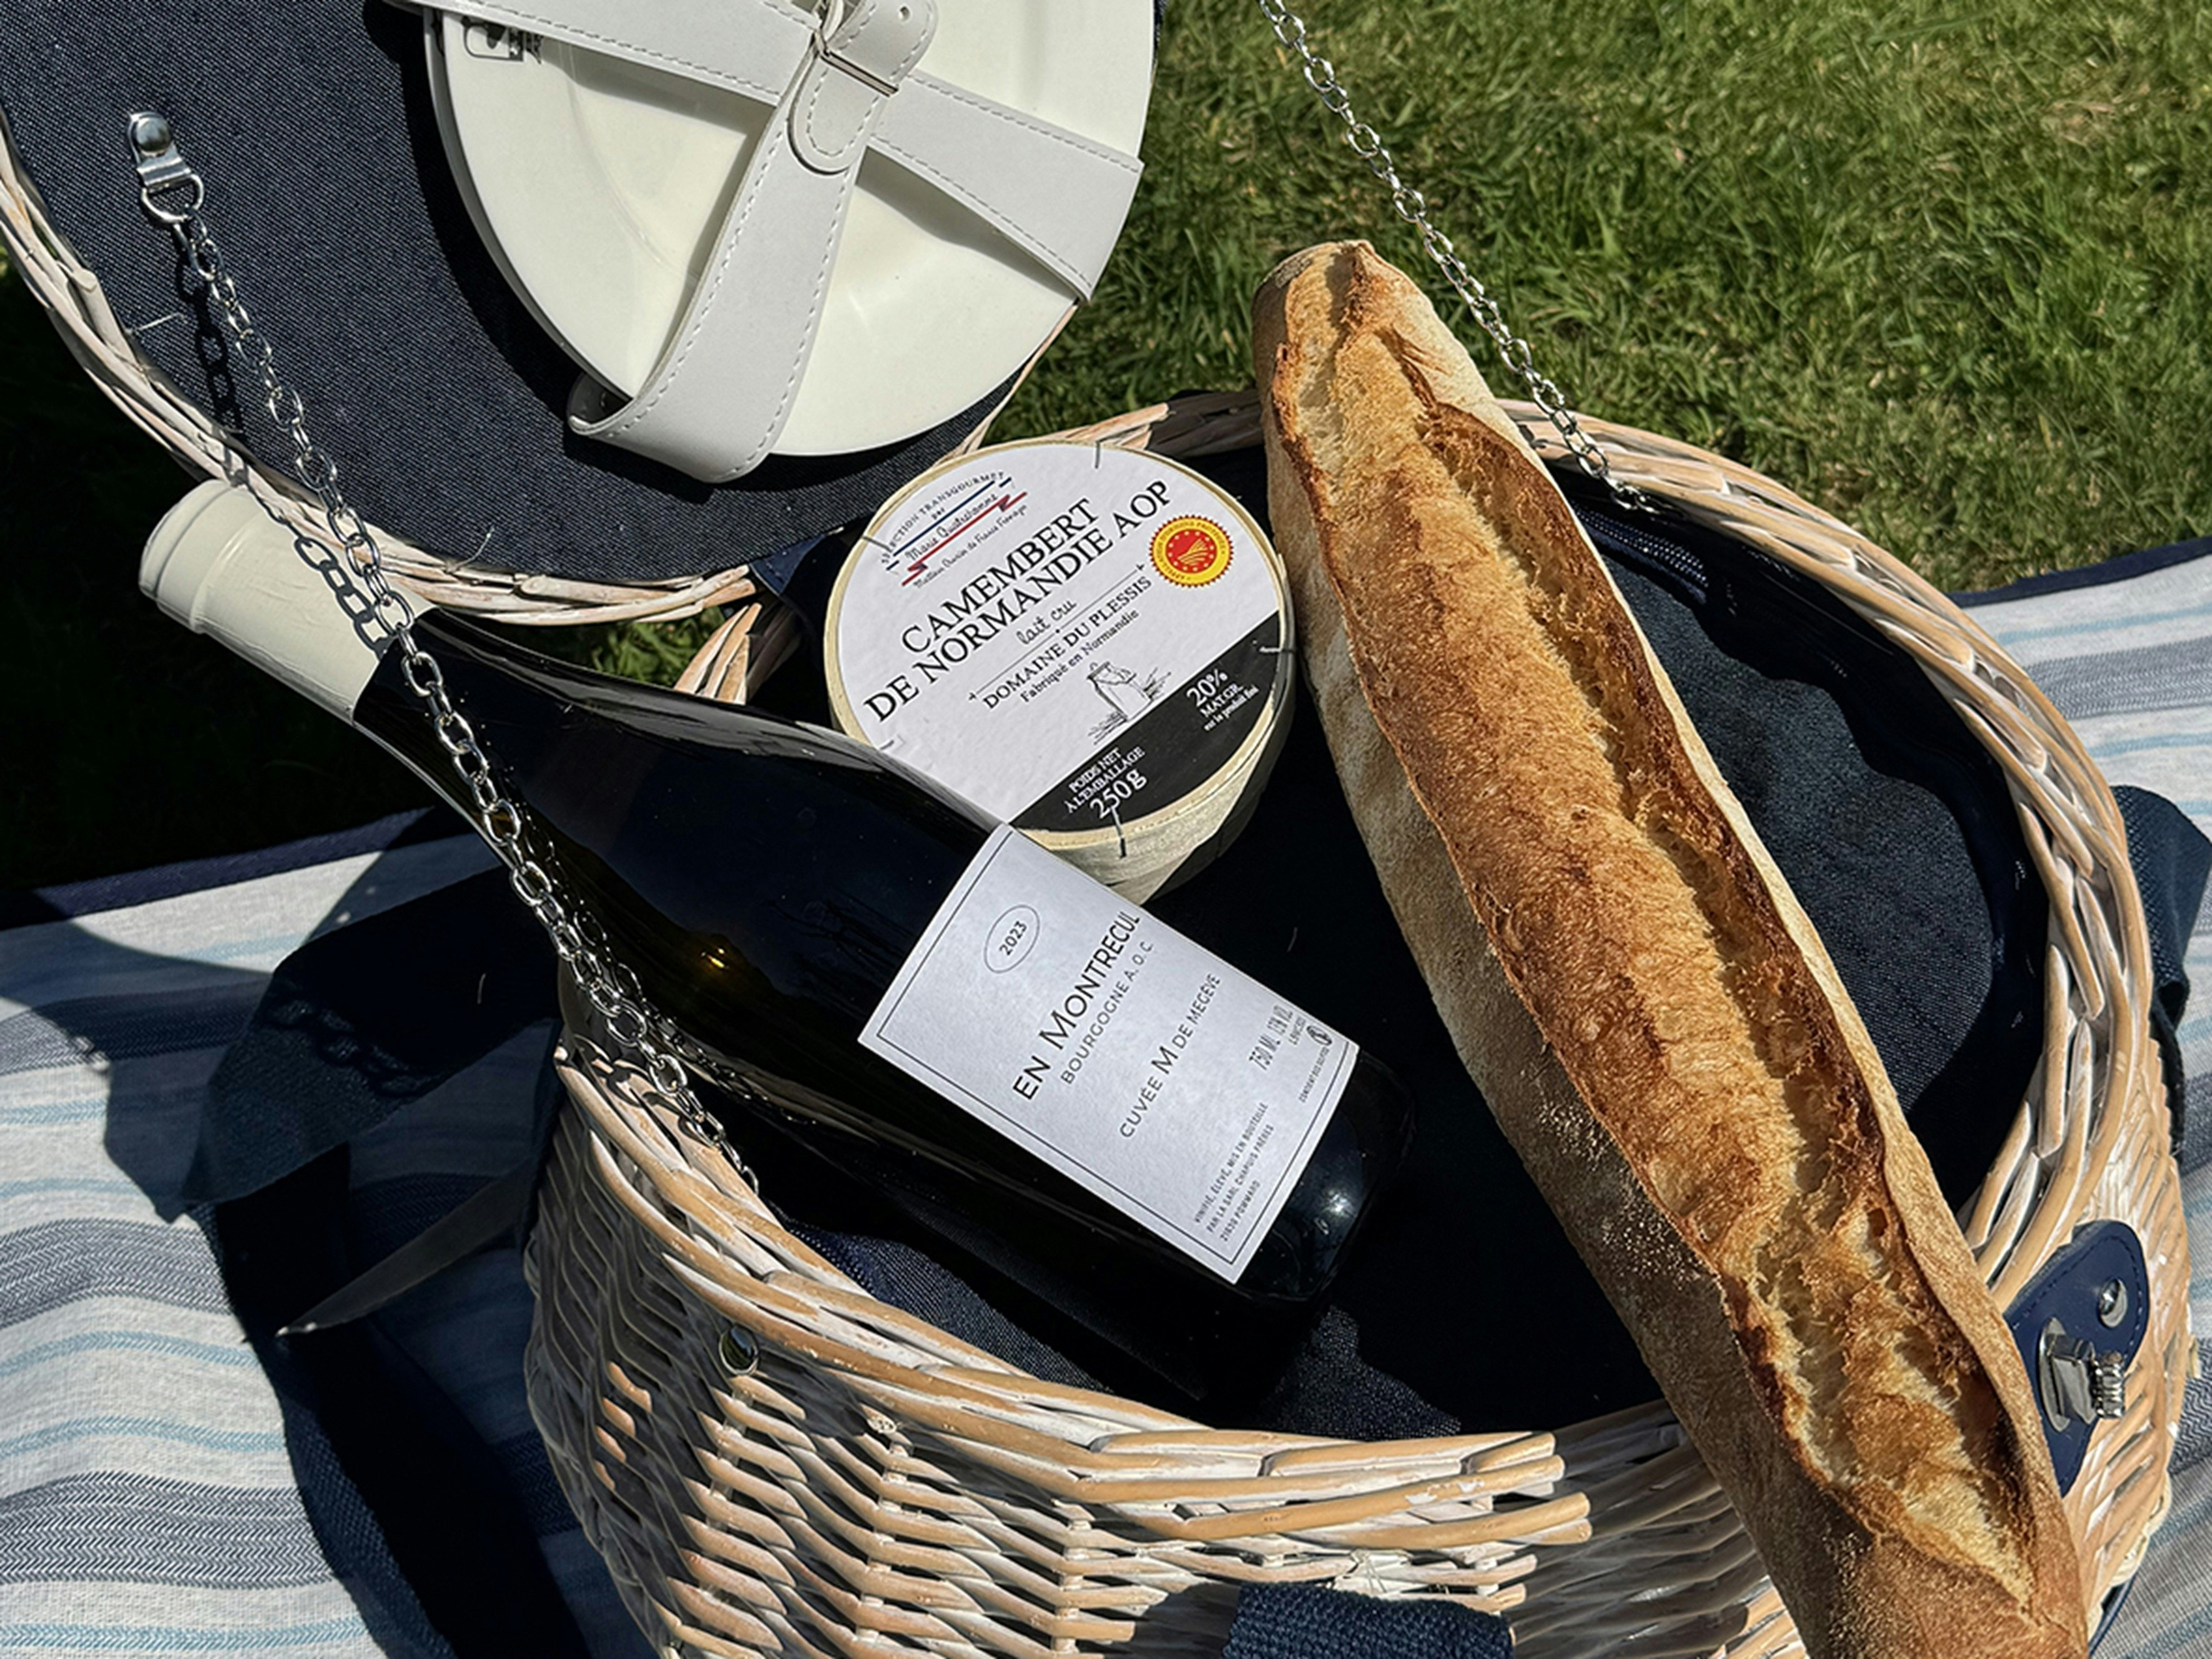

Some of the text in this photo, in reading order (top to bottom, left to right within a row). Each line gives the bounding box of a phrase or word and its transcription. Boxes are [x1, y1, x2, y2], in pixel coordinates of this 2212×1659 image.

[902, 498, 1098, 652] CAMEMBERT
[903, 537, 940, 561] Marie
[863, 675, 919, 722] DE
[913, 528, 1113, 683] NORMANDIE
[1113, 481, 1169, 538] AOP
[1015, 600, 1077, 645] lait cru
[983, 576, 1151, 708] DOMAINE DU PLESSIS
[1020, 610, 1139, 702] Fabriqué en Normandie
[1186, 669, 1227, 706] 20%
[1068, 746, 1121, 793] POIDS NET
[998, 920, 1027, 956] 2023
[1012, 911, 1139, 1100] EN MONTRECUL
[1059, 981, 1129, 1084] BOURGOGNE
[1119, 1076, 1163, 1137] CUVÉE
[1150, 1045, 1179, 1075] M
[1171, 1023, 1194, 1049] DE
[1234, 1140, 1246, 1153] EN
[1215, 1205, 1227, 1218] LA
